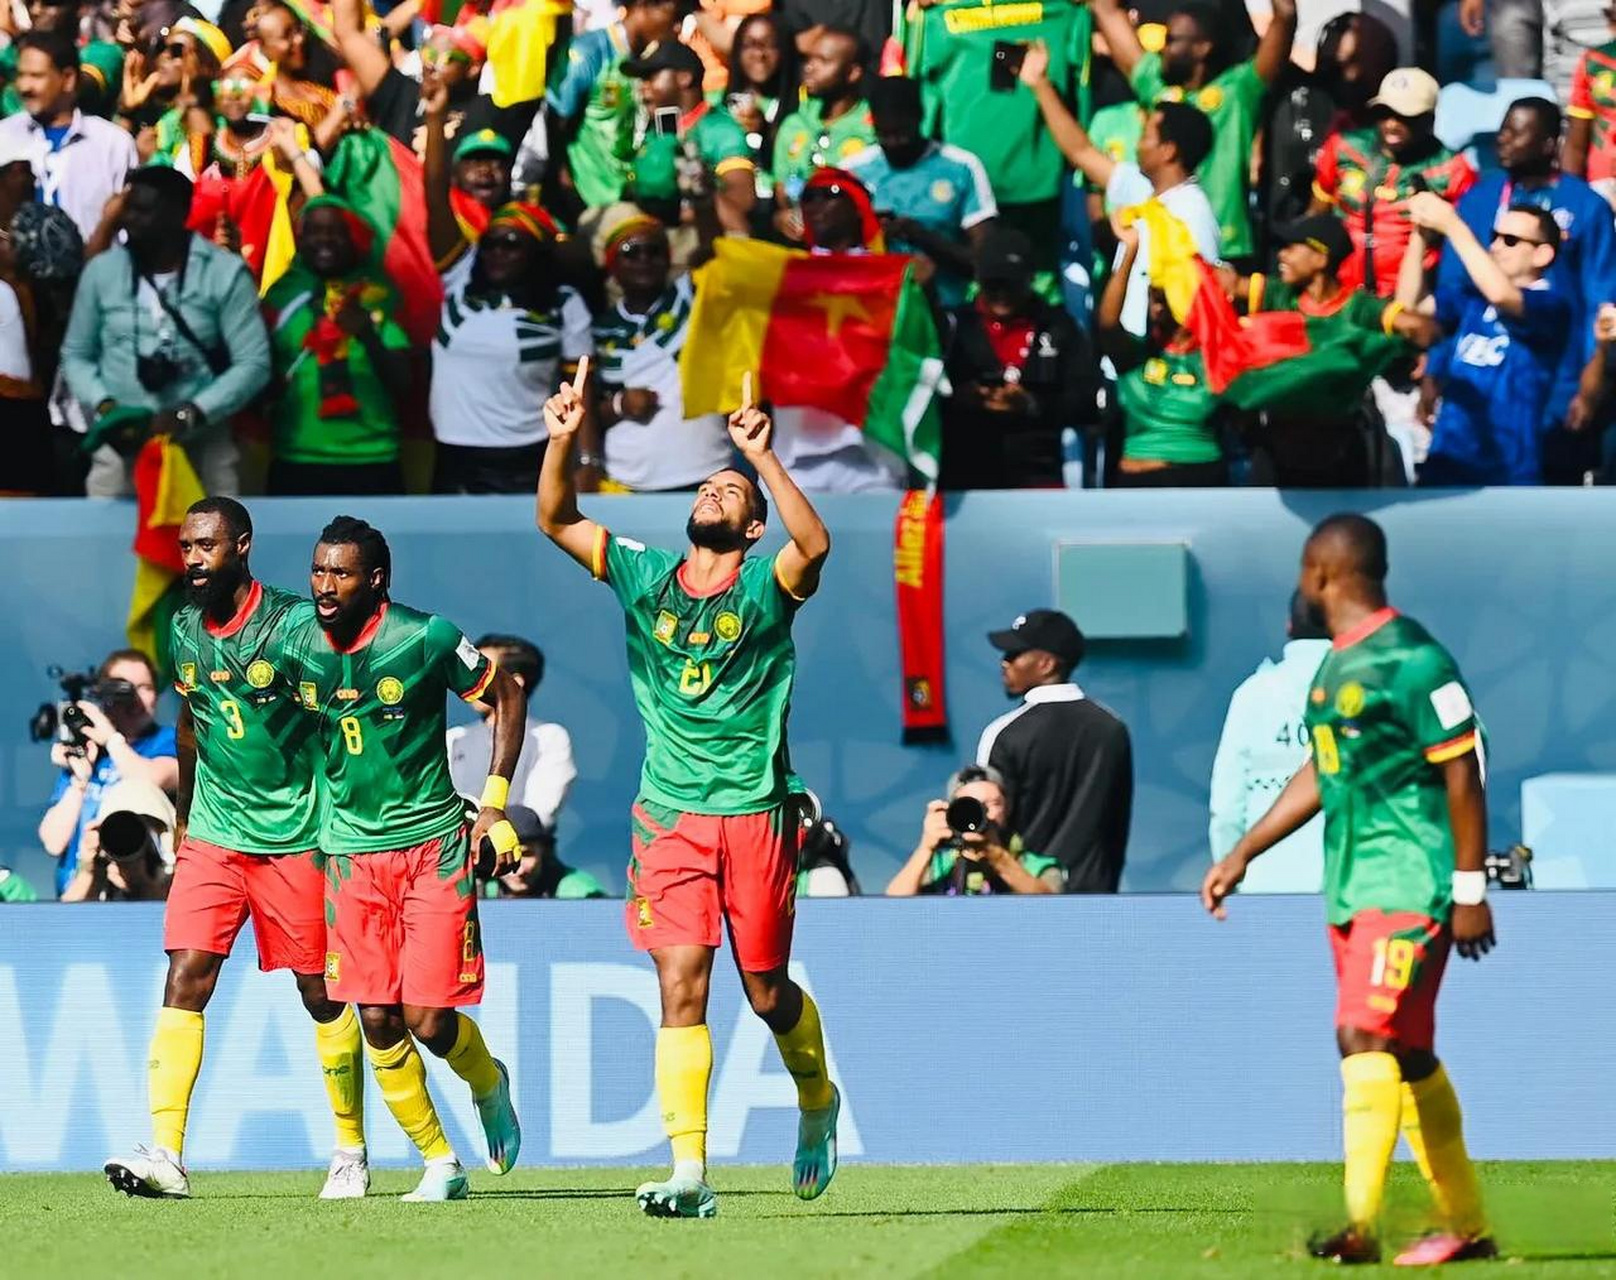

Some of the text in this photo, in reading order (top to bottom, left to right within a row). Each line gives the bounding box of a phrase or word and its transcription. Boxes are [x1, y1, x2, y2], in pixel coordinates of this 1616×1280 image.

[220, 700, 245, 740] 3
[340, 716, 364, 756] 8
[1370, 937, 1415, 990] 19
[0, 960, 865, 1161] WANDA
